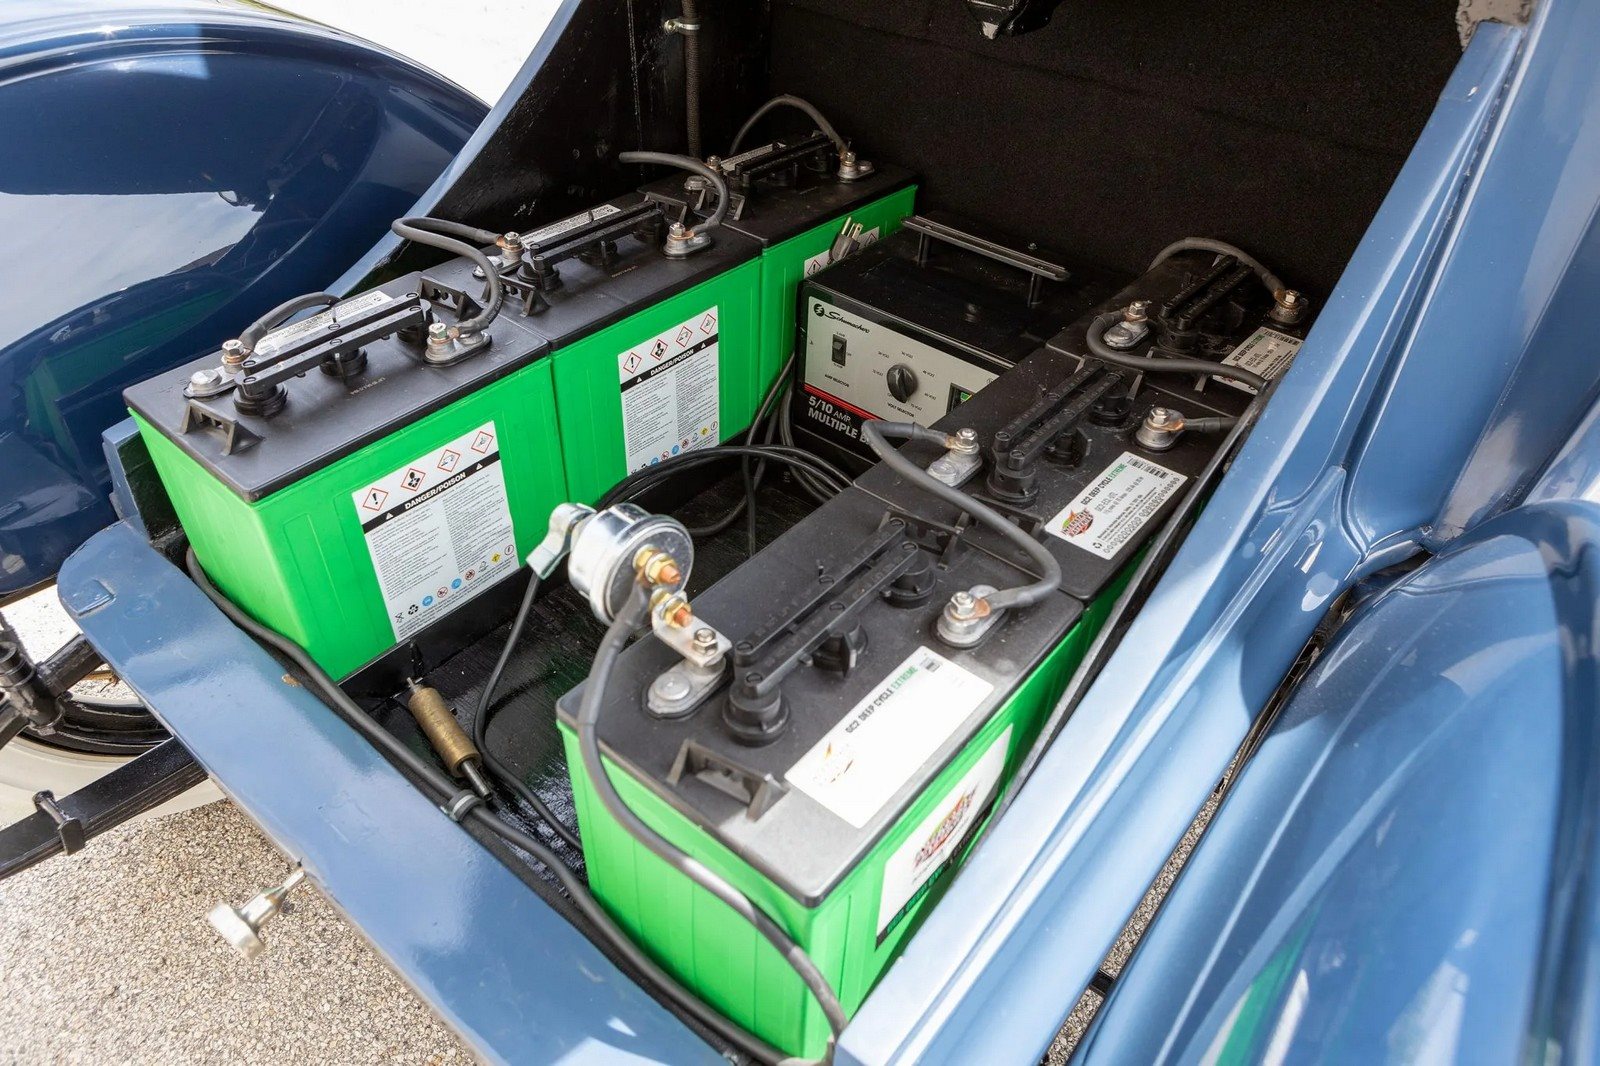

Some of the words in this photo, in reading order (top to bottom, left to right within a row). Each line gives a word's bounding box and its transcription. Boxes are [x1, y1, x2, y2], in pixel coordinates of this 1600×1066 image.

[650, 349, 694, 376] DANGER/POISON
[808, 396, 833, 414] 5/10
[834, 410, 851, 422] AMP
[808, 408, 858, 438] MULTIPLE
[404, 471, 466, 510] DANGER/POISON
[1088, 486, 1100, 498] DEEP
[1098, 477, 1112, 489] CYCLE
[1062, 509, 1090, 535] INTERSTATE
[845, 720, 860, 733] GC2
[858, 705, 875, 722] DEEP
[874, 688, 894, 707] CYCLE
[891, 666, 919, 690] EXTREME
